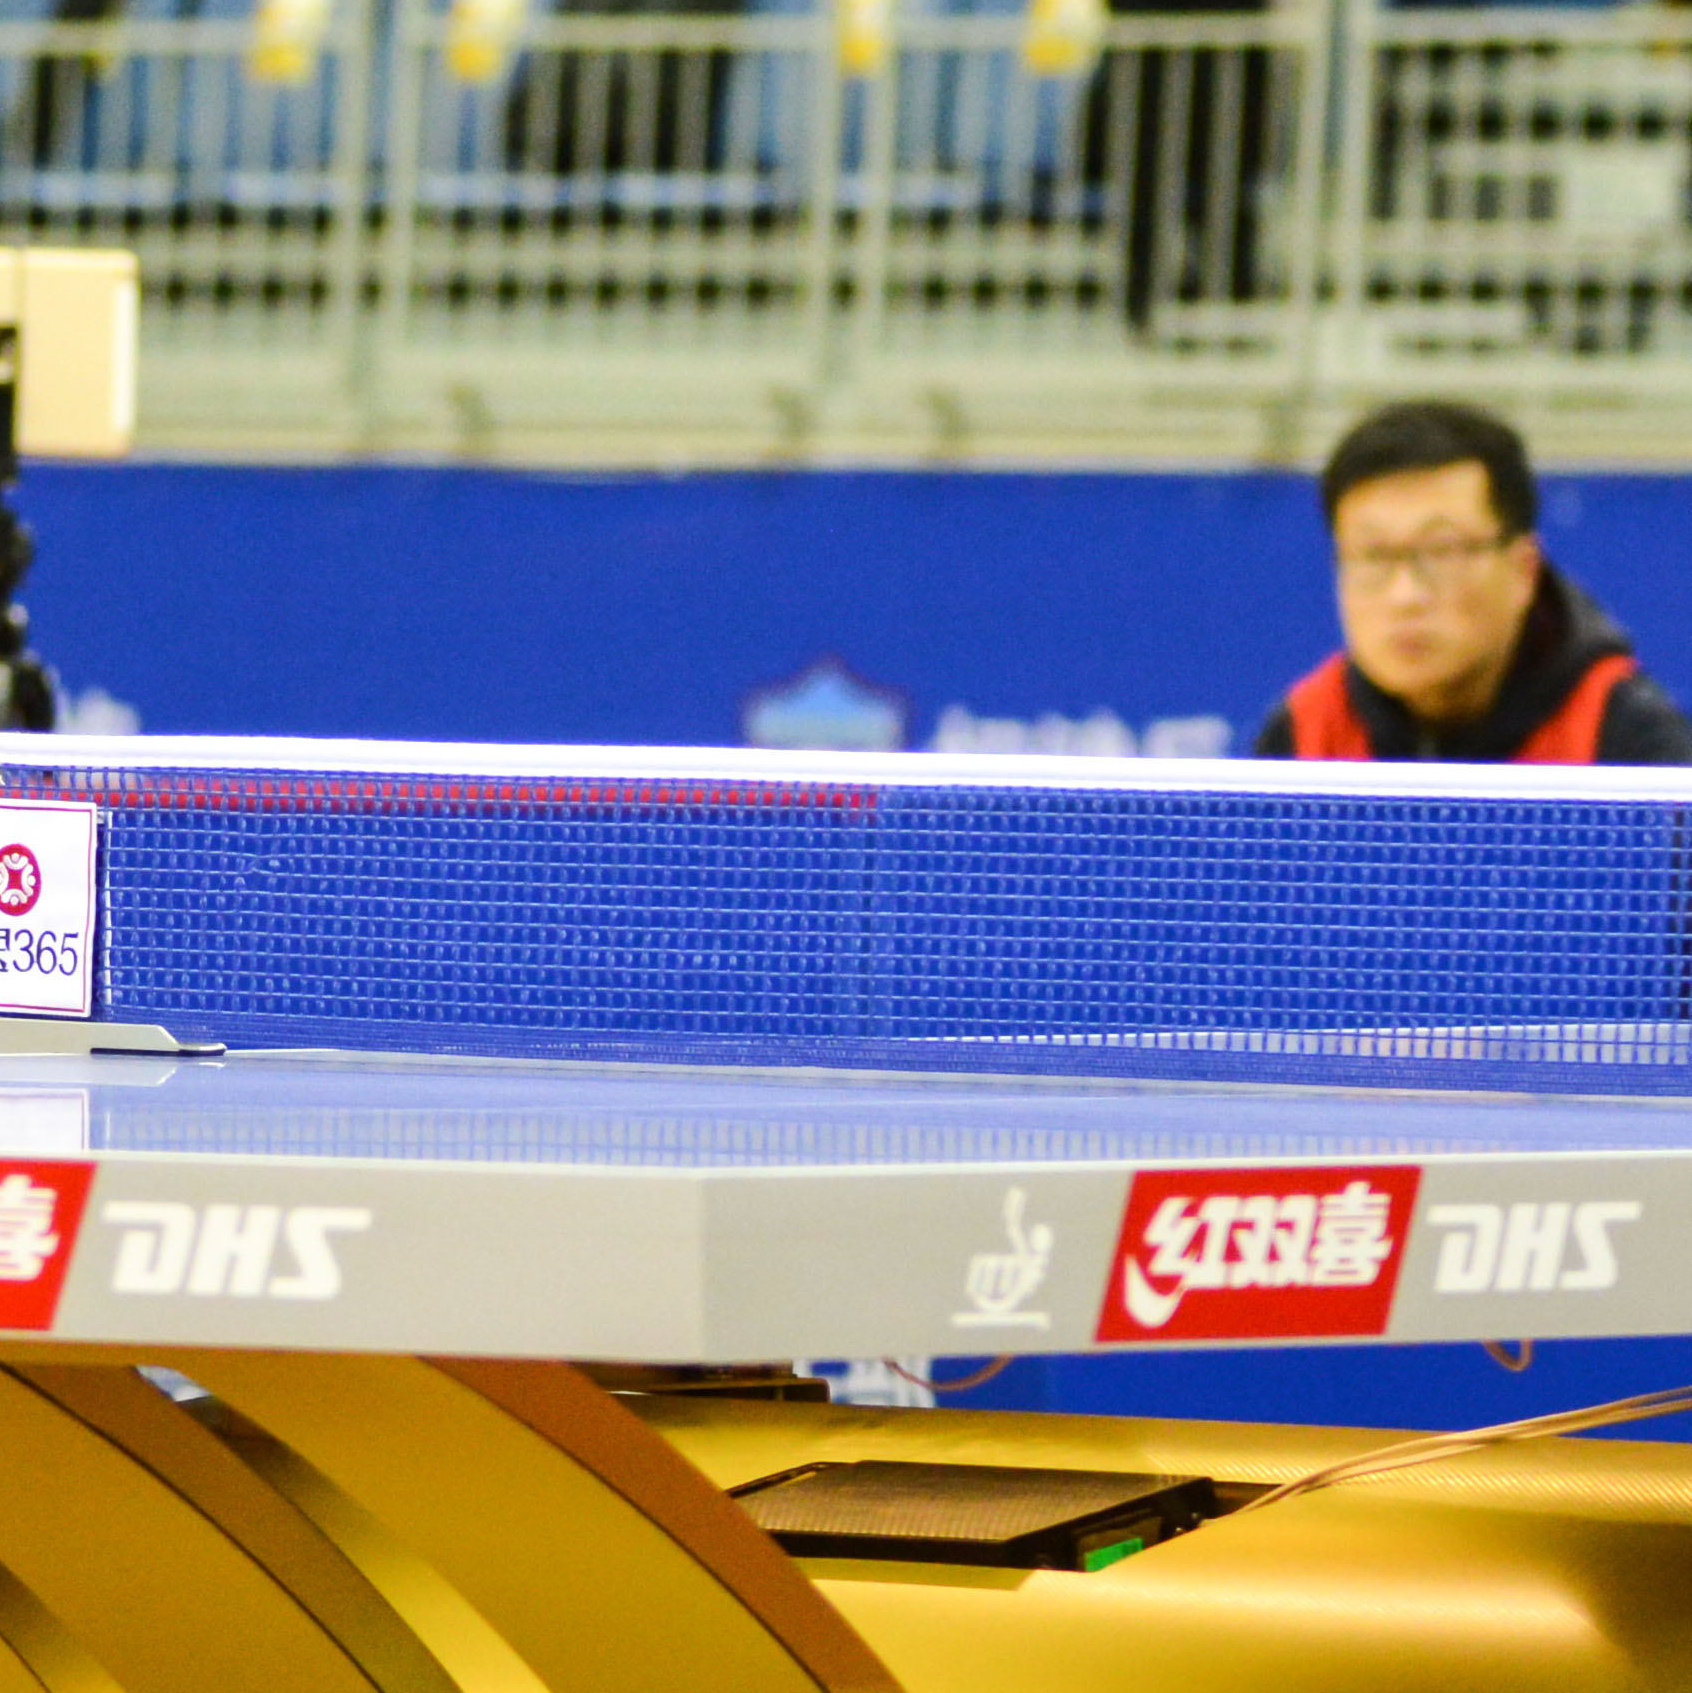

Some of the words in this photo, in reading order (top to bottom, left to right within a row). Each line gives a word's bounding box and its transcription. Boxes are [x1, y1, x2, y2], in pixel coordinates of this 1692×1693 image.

[102, 1199, 373, 1301] DHS
[1123, 1182, 1394, 1328] 红双喜
[1427, 1200, 1643, 1293] DHS
